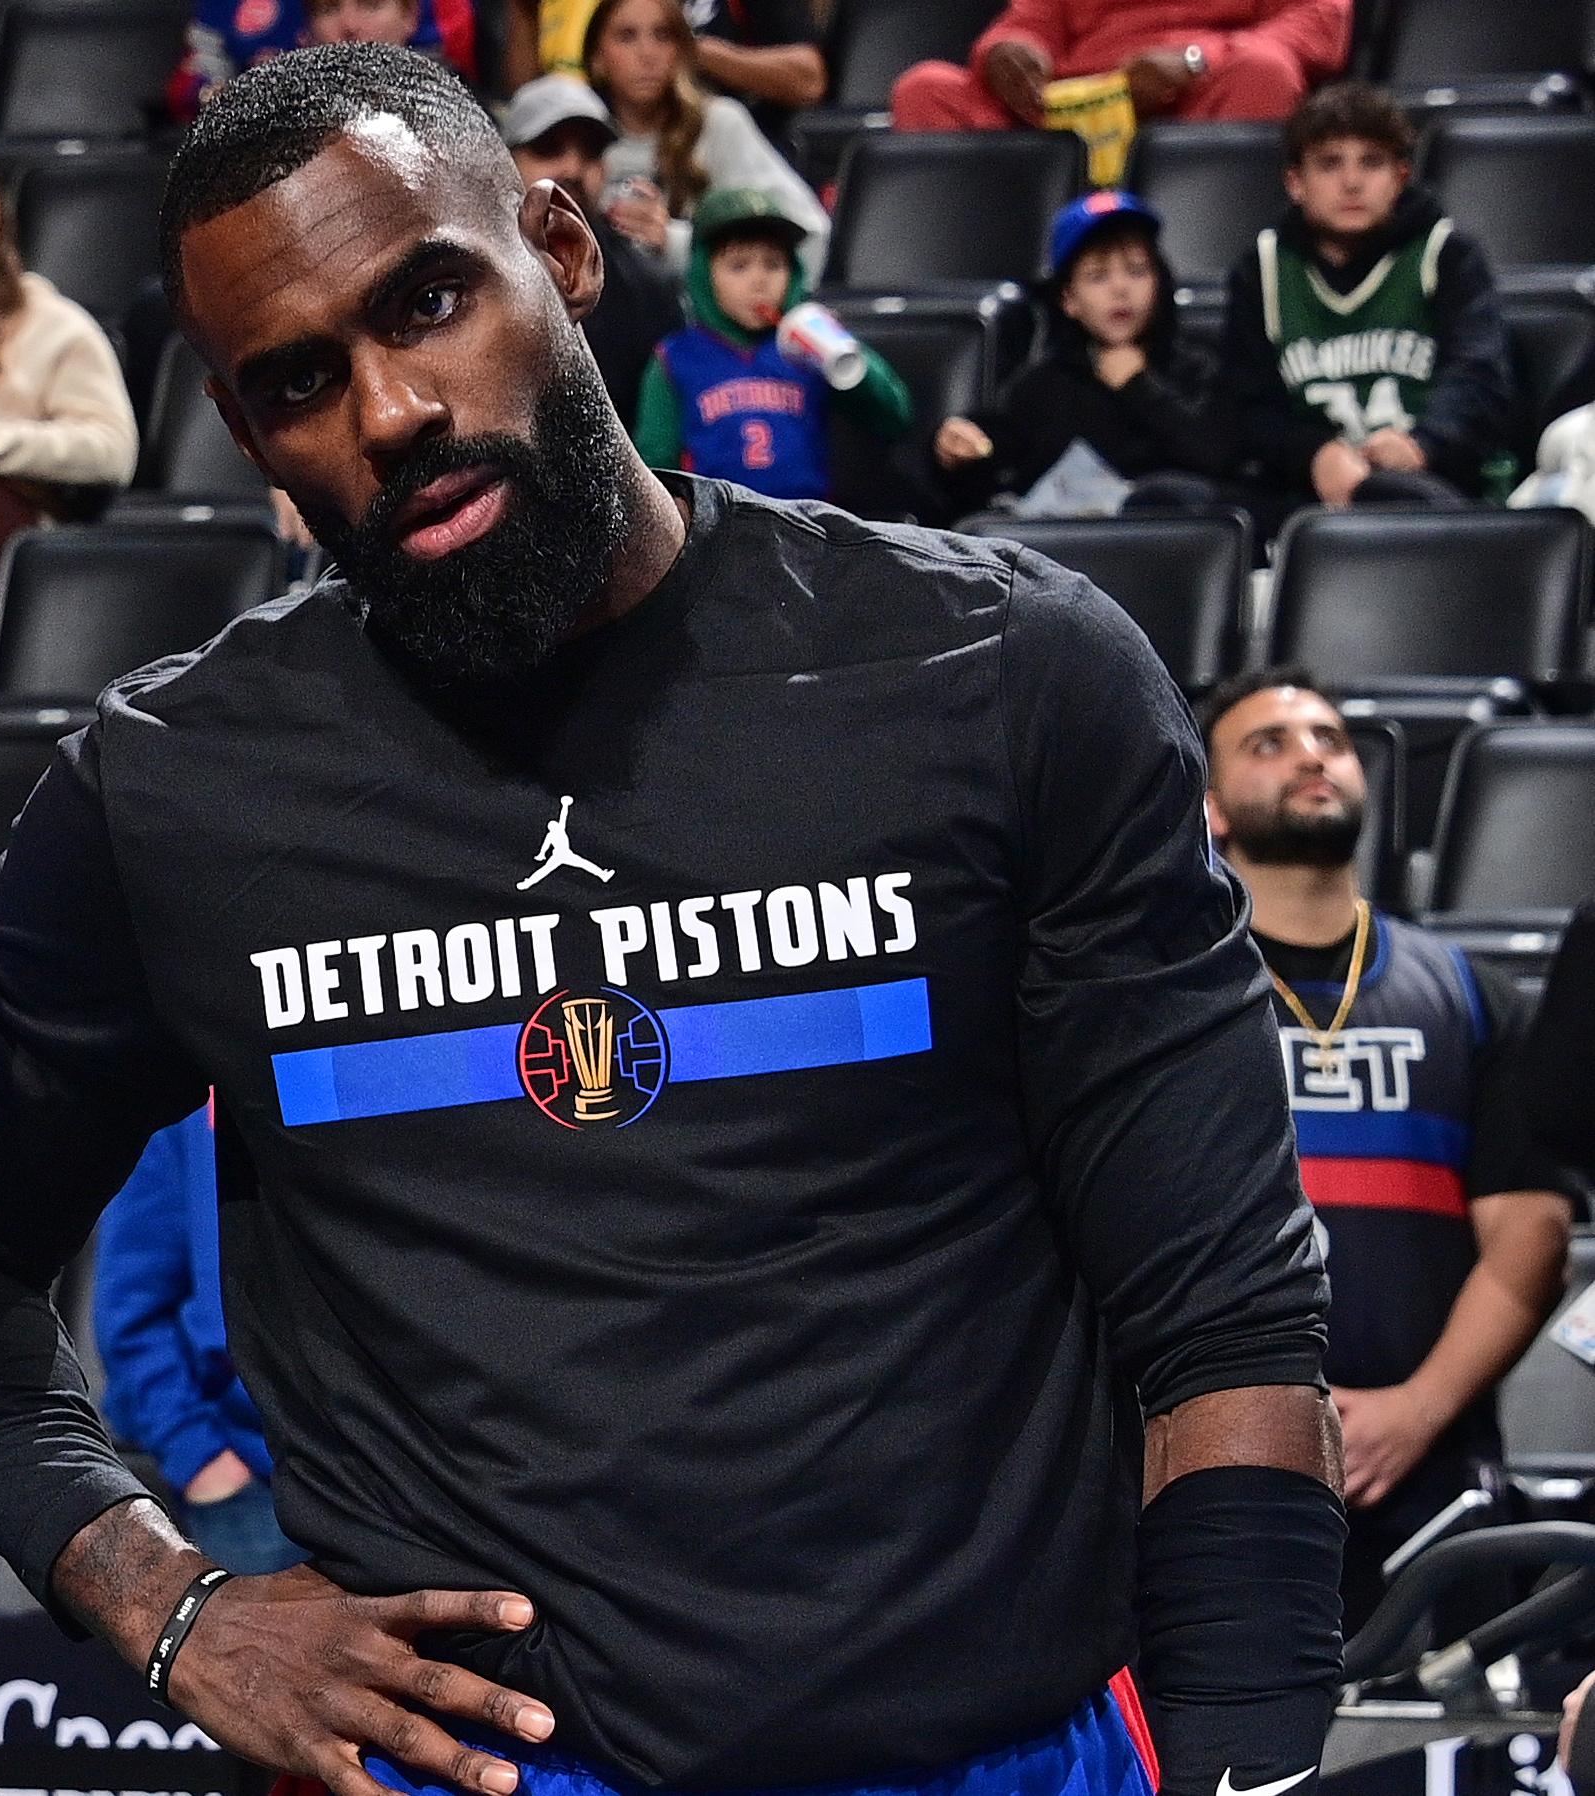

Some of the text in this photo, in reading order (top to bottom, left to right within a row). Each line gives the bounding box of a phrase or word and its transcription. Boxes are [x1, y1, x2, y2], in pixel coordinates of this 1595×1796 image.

[741, 420, 774, 469] 2
[250, 872, 917, 1029] DETROIT PISTONS
[149, 1661, 162, 1689] TIM
